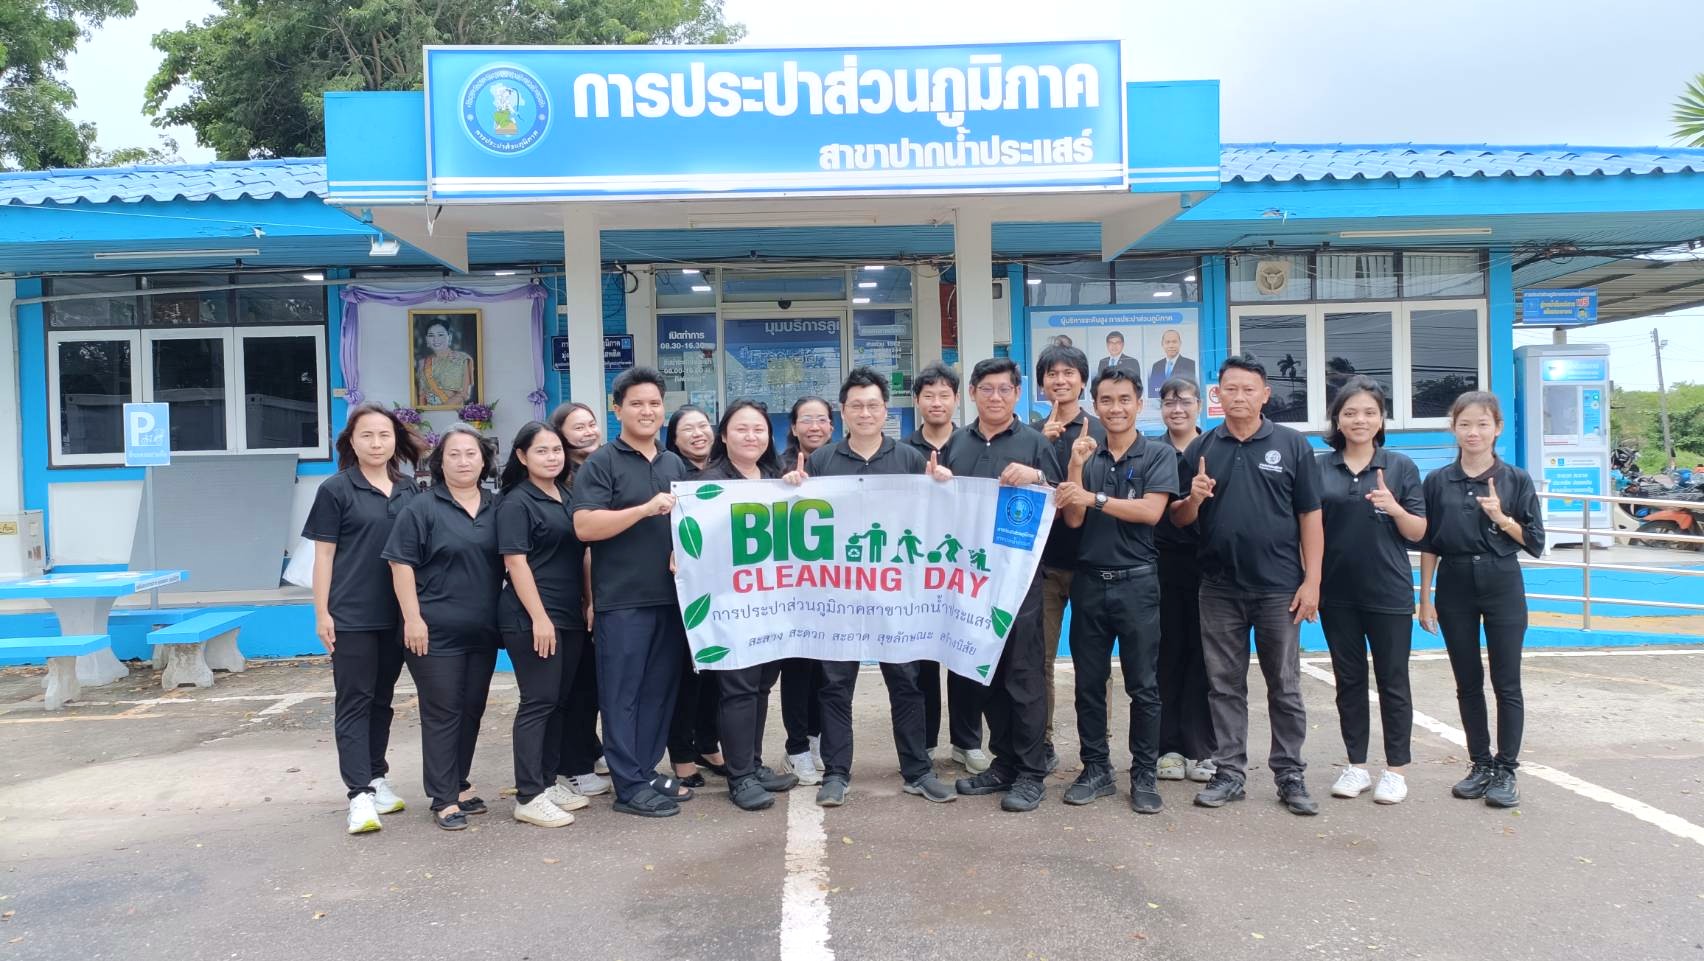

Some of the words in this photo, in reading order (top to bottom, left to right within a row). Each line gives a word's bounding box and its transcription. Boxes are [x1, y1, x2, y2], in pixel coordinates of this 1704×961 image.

[573, 53, 1100, 126] การประปาส่วนภูมิภาค
[818, 127, 1094, 170] สาขาปากน้ำประแสร์
[130, 411, 156, 447] P
[730, 499, 835, 566] BIG
[732, 565, 902, 593] CLEANING
[924, 566, 990, 598] DAY
[788, 628, 825, 640] สะดวก
[832, 632, 870, 642] สะอาด
[876, 630, 934, 646] สุขลักษณะ
